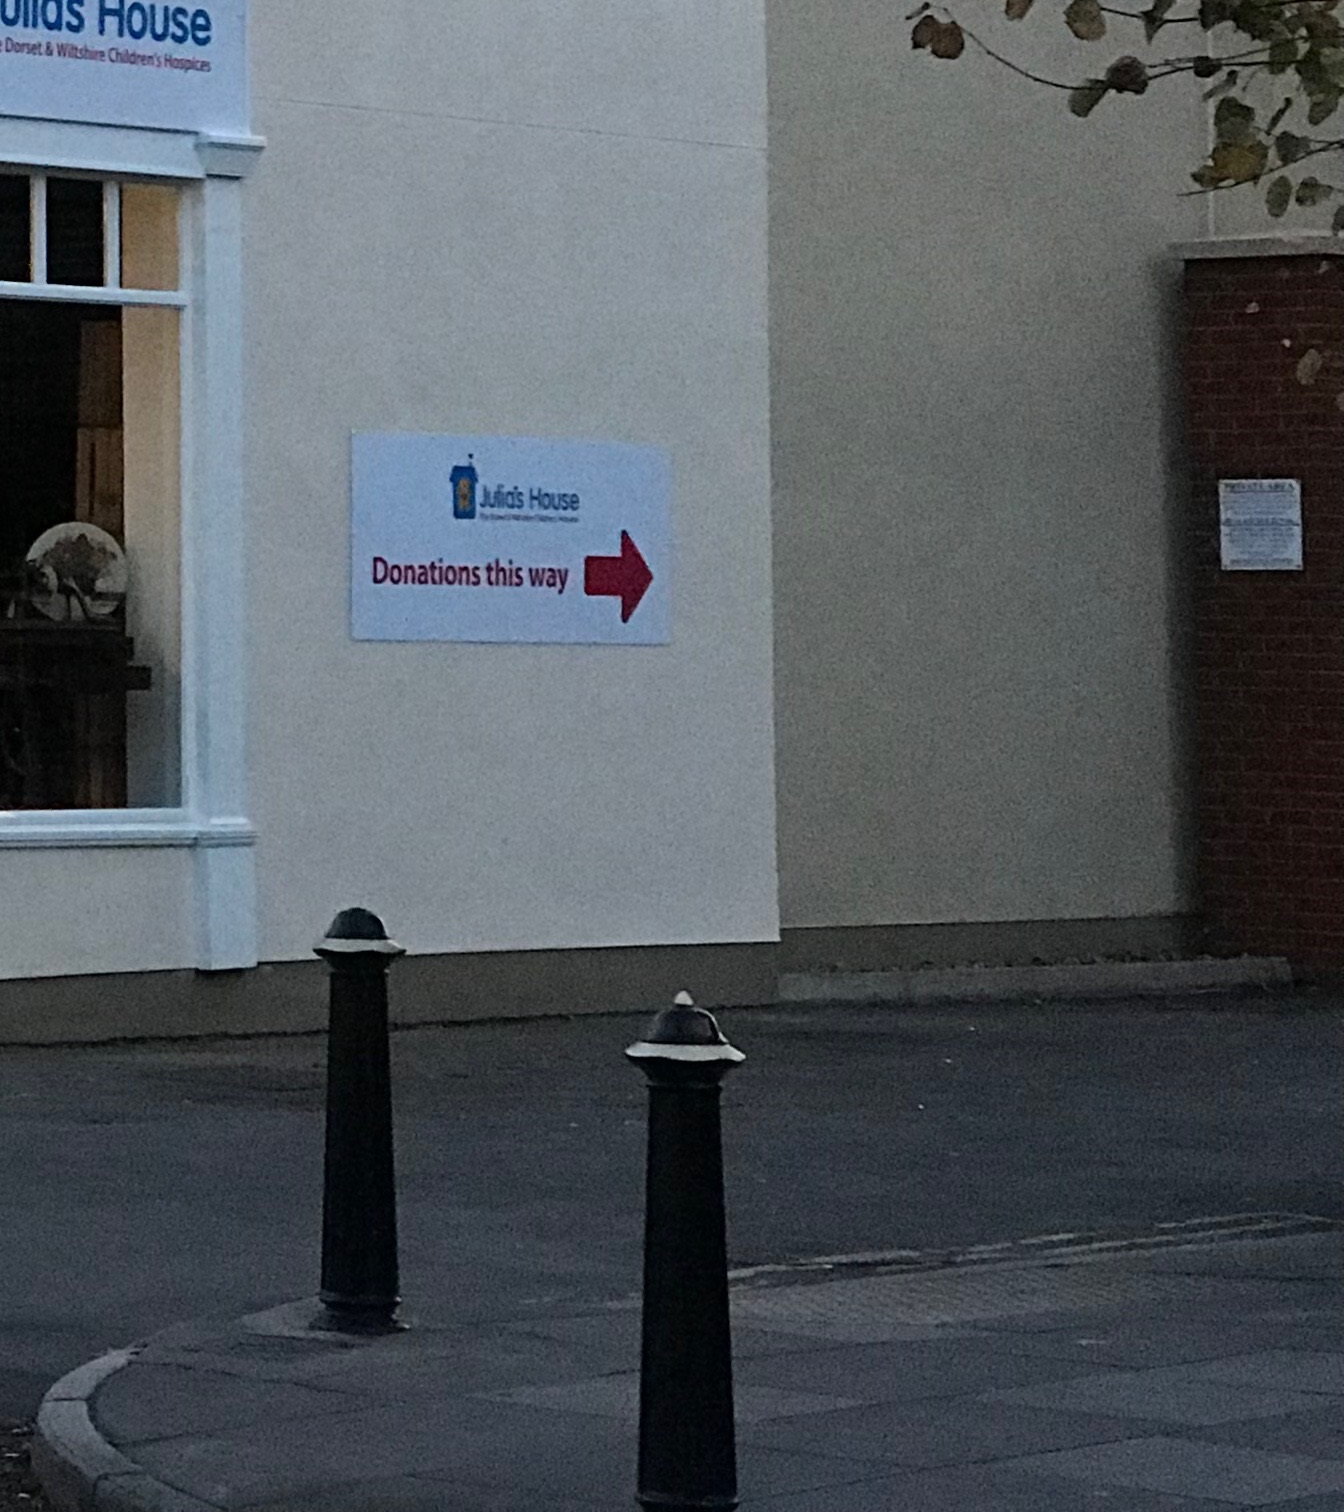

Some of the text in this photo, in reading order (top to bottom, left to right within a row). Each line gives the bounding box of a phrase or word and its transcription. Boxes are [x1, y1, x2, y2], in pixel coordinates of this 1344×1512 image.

[4, 37, 42, 56] Dorset
[45, 41, 53, 56] &
[56, 43, 107, 62] Wiltshire
[108, 48, 163, 67] Children's
[529, 487, 580, 511] House
[372, 556, 569, 595] Donations this way
